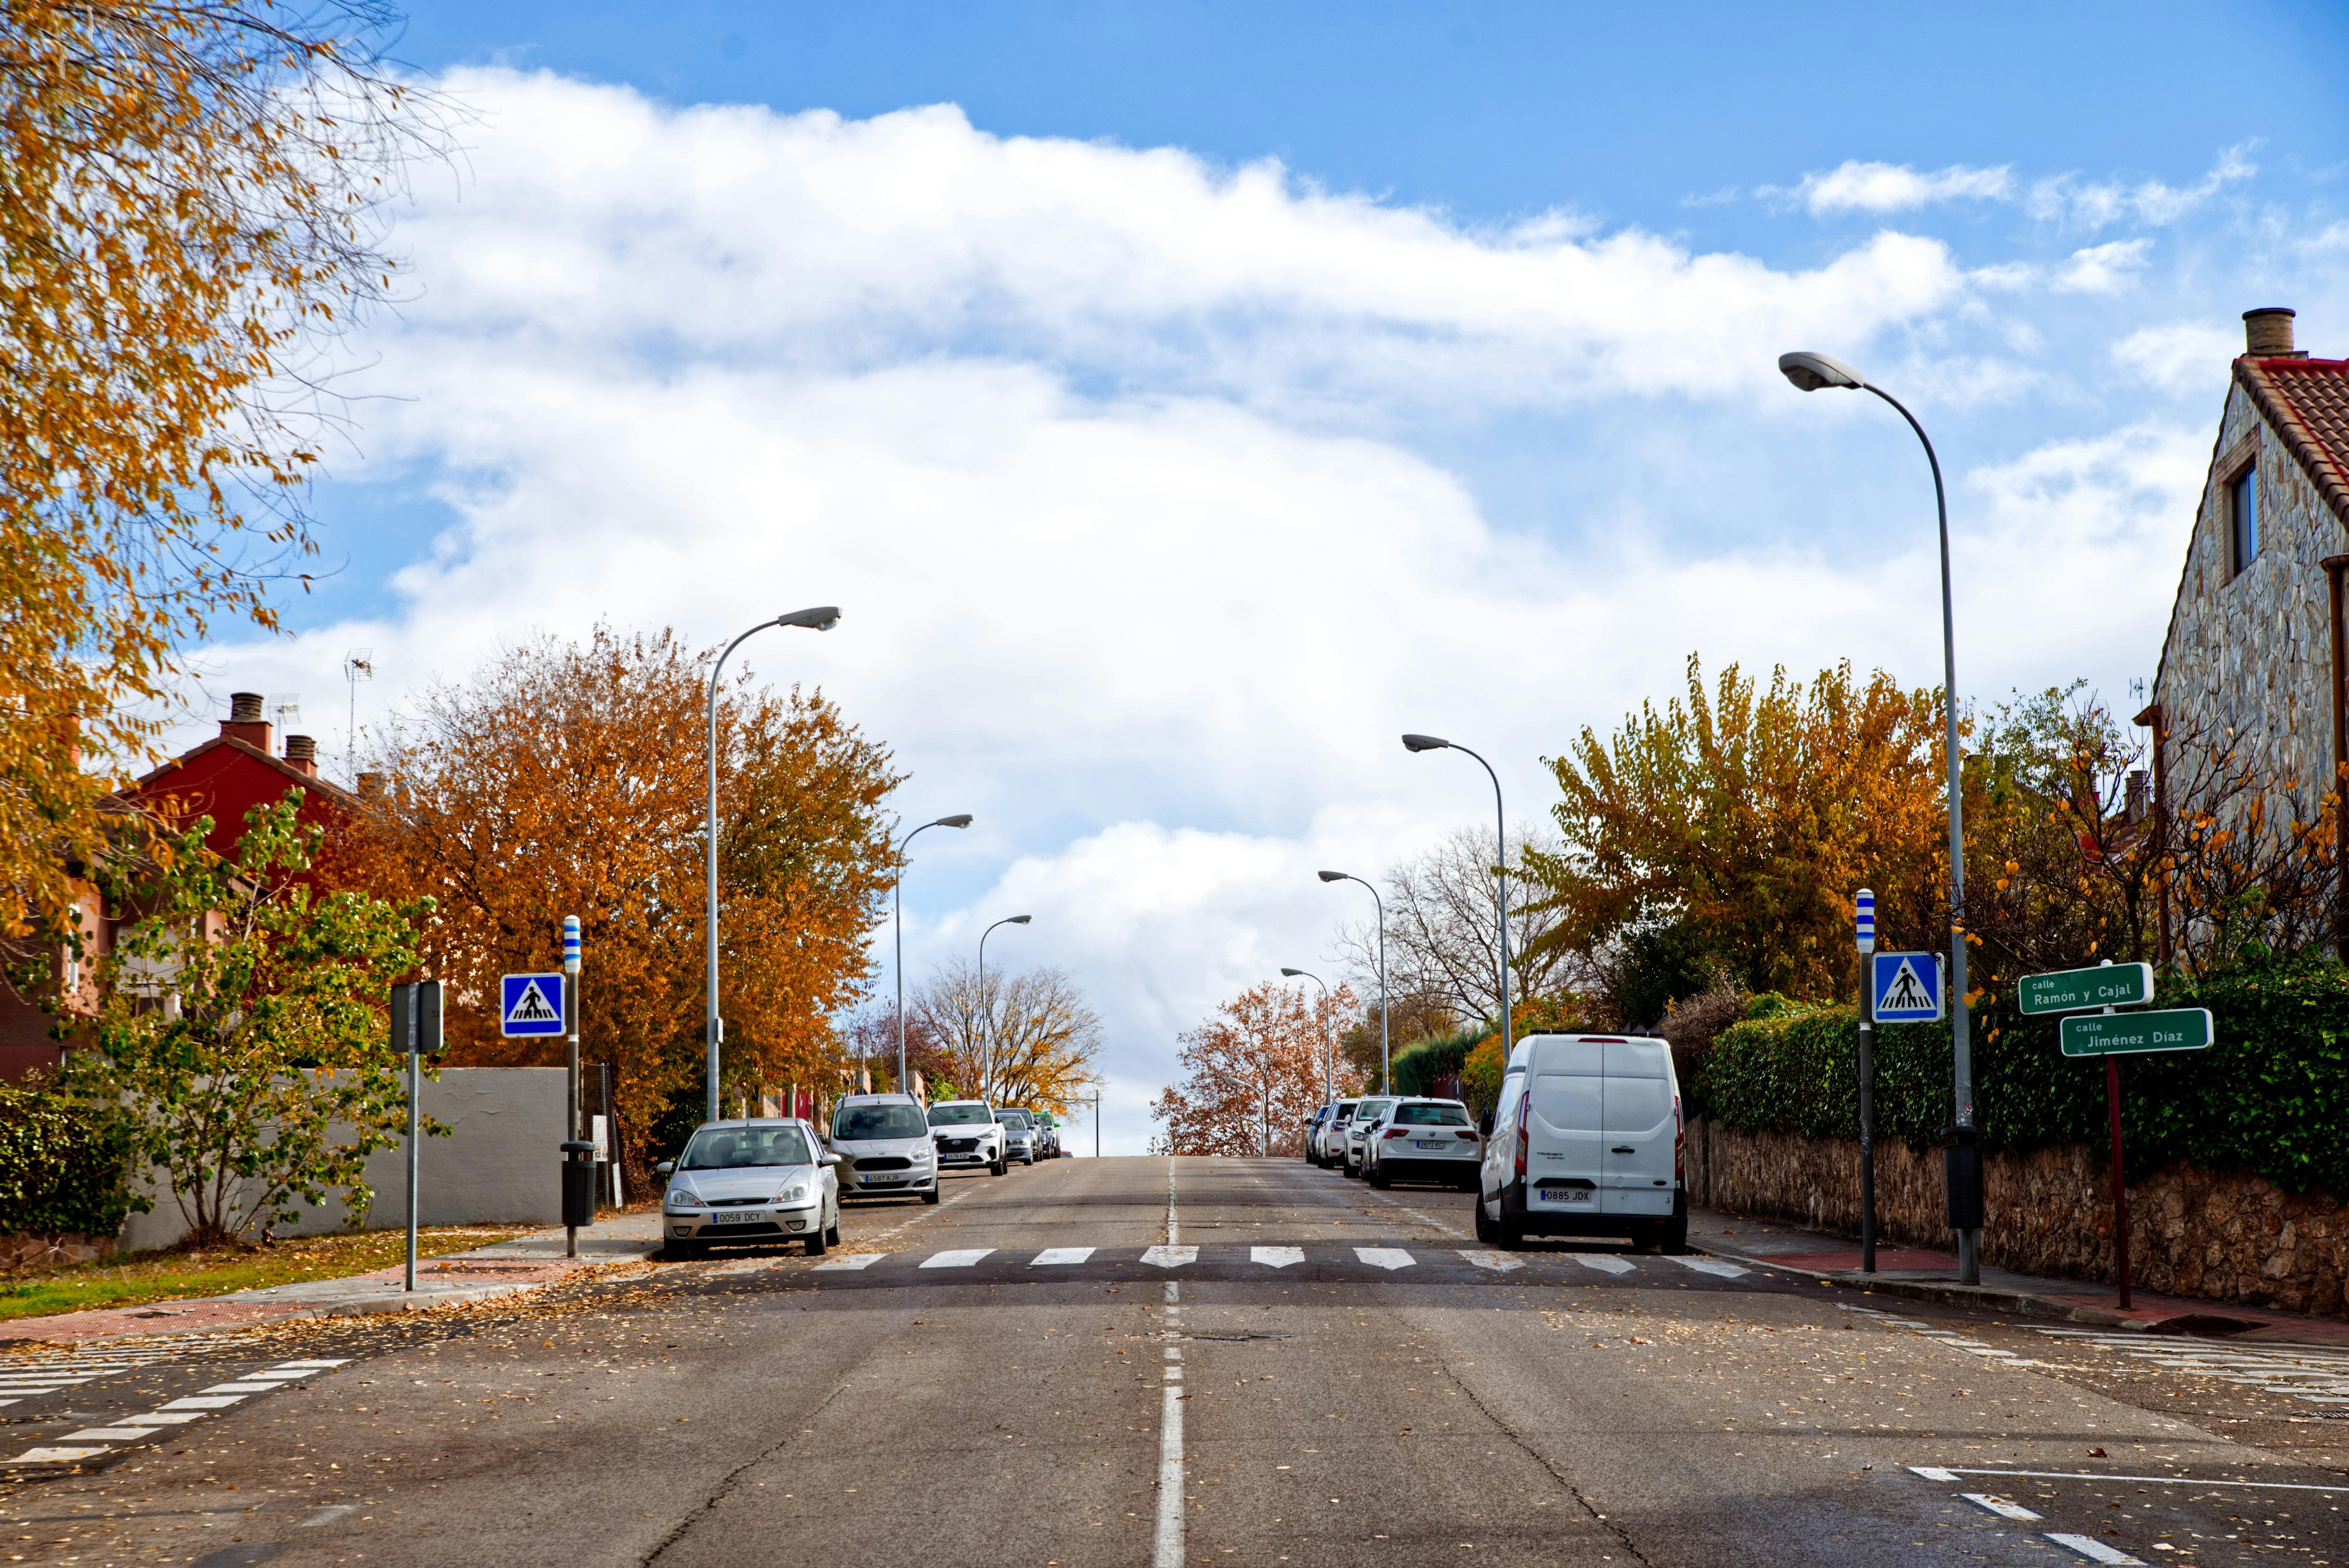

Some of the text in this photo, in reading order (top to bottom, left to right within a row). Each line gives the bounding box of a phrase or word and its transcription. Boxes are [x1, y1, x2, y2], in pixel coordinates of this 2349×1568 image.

[2033, 981, 2055, 990] calle
[2034, 983, 2131, 1005] Ramón y Cajal
[2076, 1023, 2102, 1032] calle
[2088, 1031, 2183, 1047] Jiménez Díaz
[1547, 1191, 1589, 1201] 0885 JDX
[720, 1213, 760, 1222] 0059 DCY
